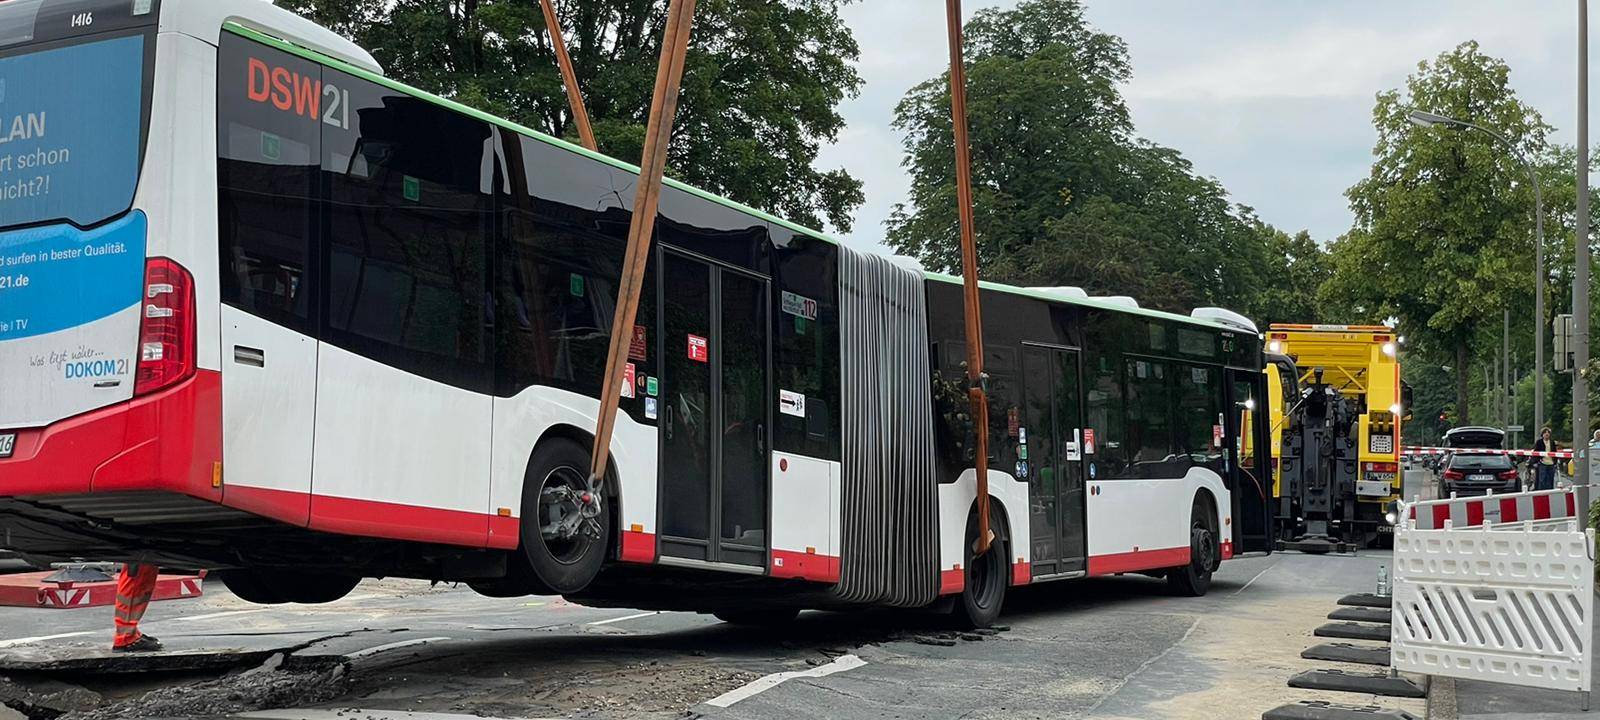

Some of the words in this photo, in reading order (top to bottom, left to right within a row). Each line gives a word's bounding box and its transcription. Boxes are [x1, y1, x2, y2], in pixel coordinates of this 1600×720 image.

[71, 12, 93, 28] 1416
[248, 57, 350, 130] DSW21
[17, 146, 70, 169] schon
[7, 252, 36, 266] surfen
[39, 250, 48, 262] in
[51, 248, 82, 260] bester
[84, 242, 127, 257] Qualität.
[16, 319, 28, 330] TV
[65, 358, 129, 379] DOKOM21
